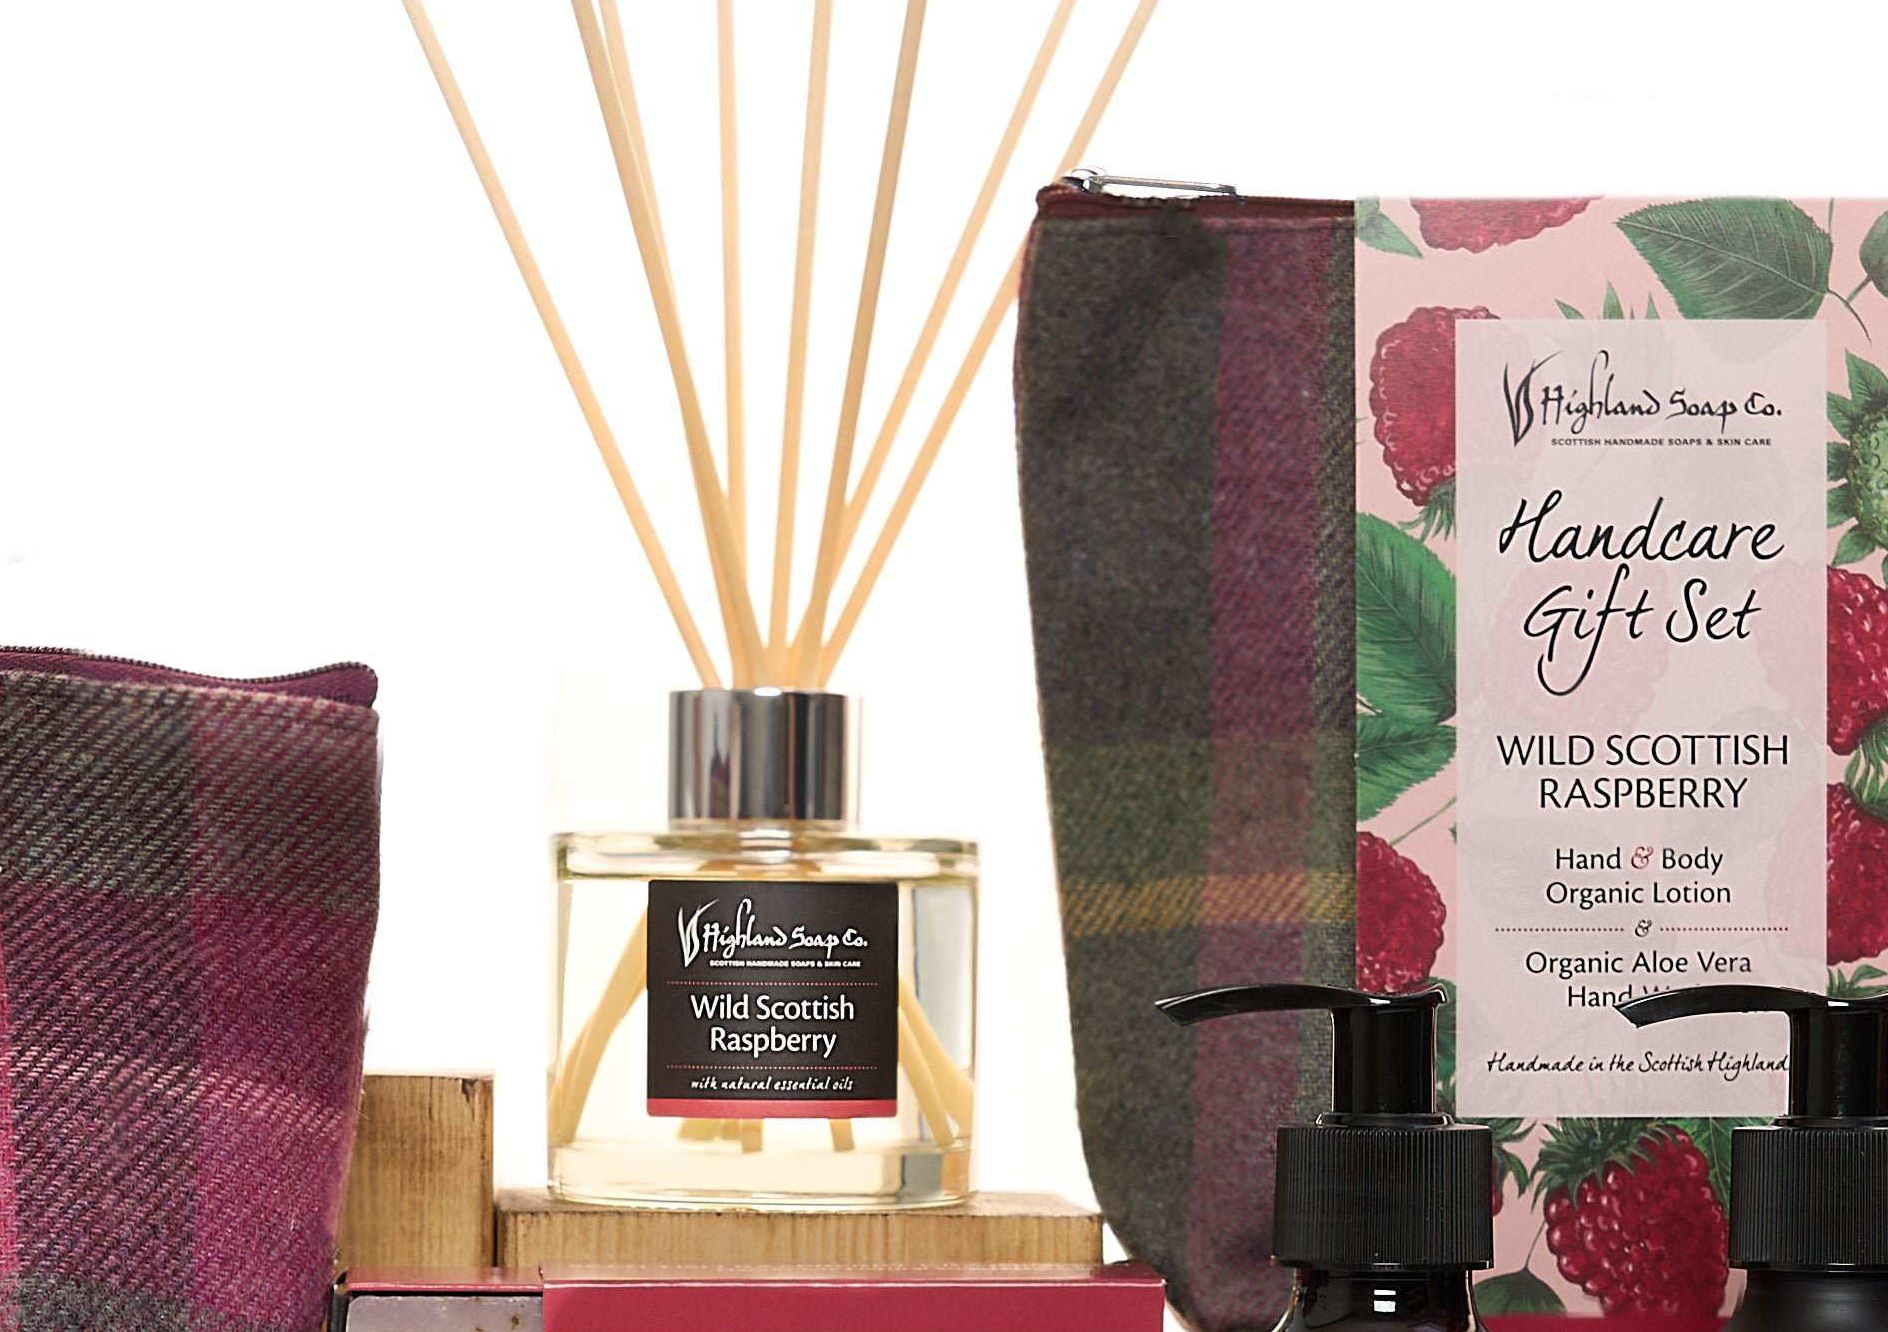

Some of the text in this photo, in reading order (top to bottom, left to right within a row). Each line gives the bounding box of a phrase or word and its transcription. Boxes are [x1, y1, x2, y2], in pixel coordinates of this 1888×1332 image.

[1499, 489, 1785, 563] Handcare
[1523, 562, 1762, 697] Gift Set
[1546, 880, 1731, 911] Organic Lotion
[1525, 949, 1752, 980] Organic Aloe Vera
[690, 993, 854, 1020] Wild Scottish
[1568, 984, 1632, 1007] Hand
[710, 1025, 837, 1059] Raspberry
[1487, 1050, 1788, 1082] Handmade in the Scottish Highland
[691, 1076, 854, 1091] with natural essential oils
